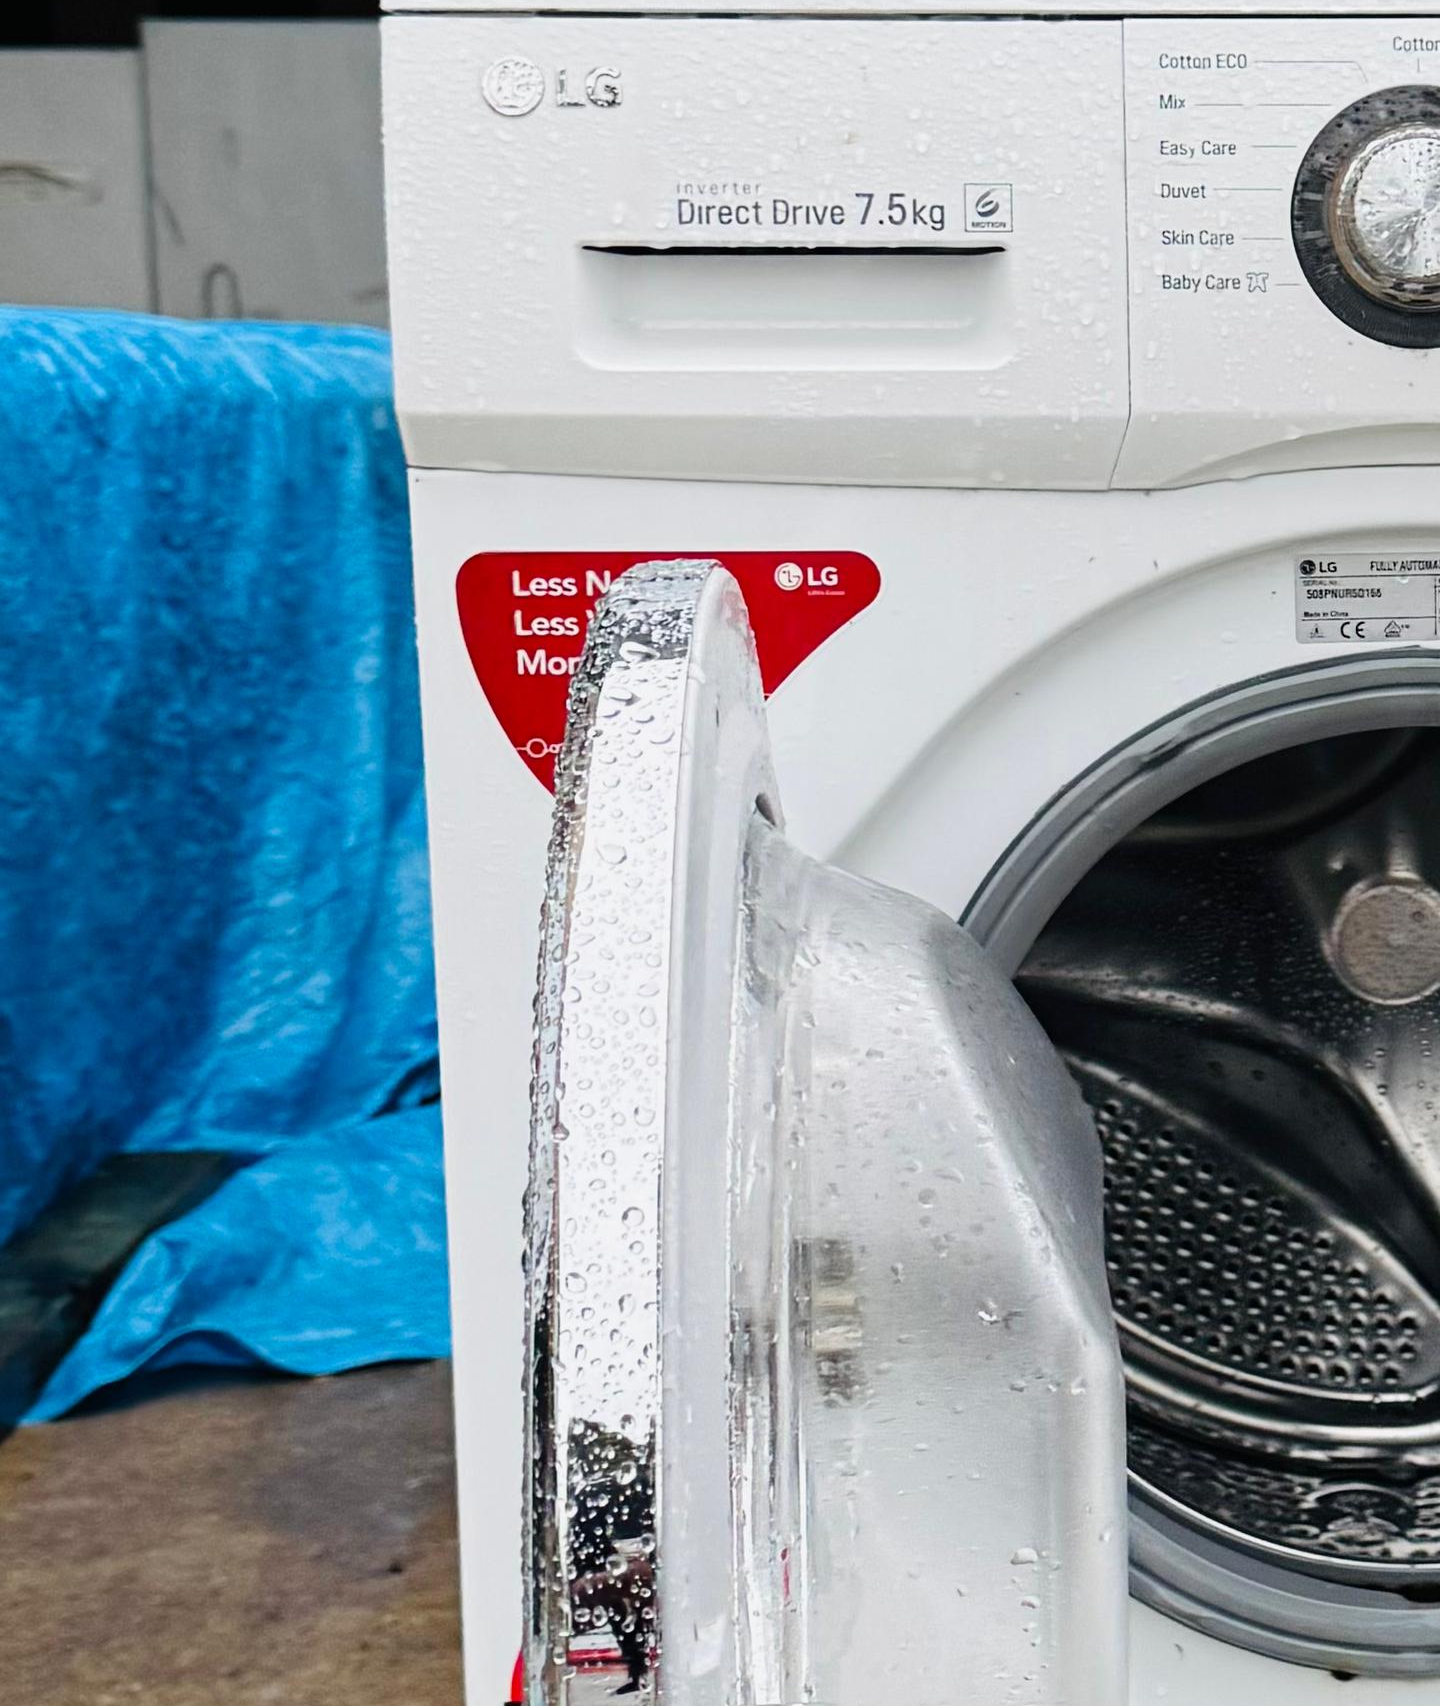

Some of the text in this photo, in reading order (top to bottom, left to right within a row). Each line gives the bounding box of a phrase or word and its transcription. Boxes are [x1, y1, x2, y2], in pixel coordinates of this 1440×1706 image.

[1159, 53, 1247, 69] Cotton ECO
[556, 66, 623, 107] LG
[1159, 94, 1186, 109] Mix
[1160, 140, 1237, 159] Easy Care
[676, 182, 762, 195] inverter
[1161, 183, 1206, 199] Duvet
[677, 199, 762, 225] Direct
[772, 199, 845, 225] Drive
[1162, 230, 1234, 246] Skin Care
[1162, 274, 1241, 293] Baby Care
[1318, 561, 1338, 573] LG
[1370, 560, 1398, 571] FULLY
[512, 569, 578, 596] Less
[807, 566, 839, 587] LG
[514, 609, 580, 636] Less
[516, 648, 583, 675] Mor
